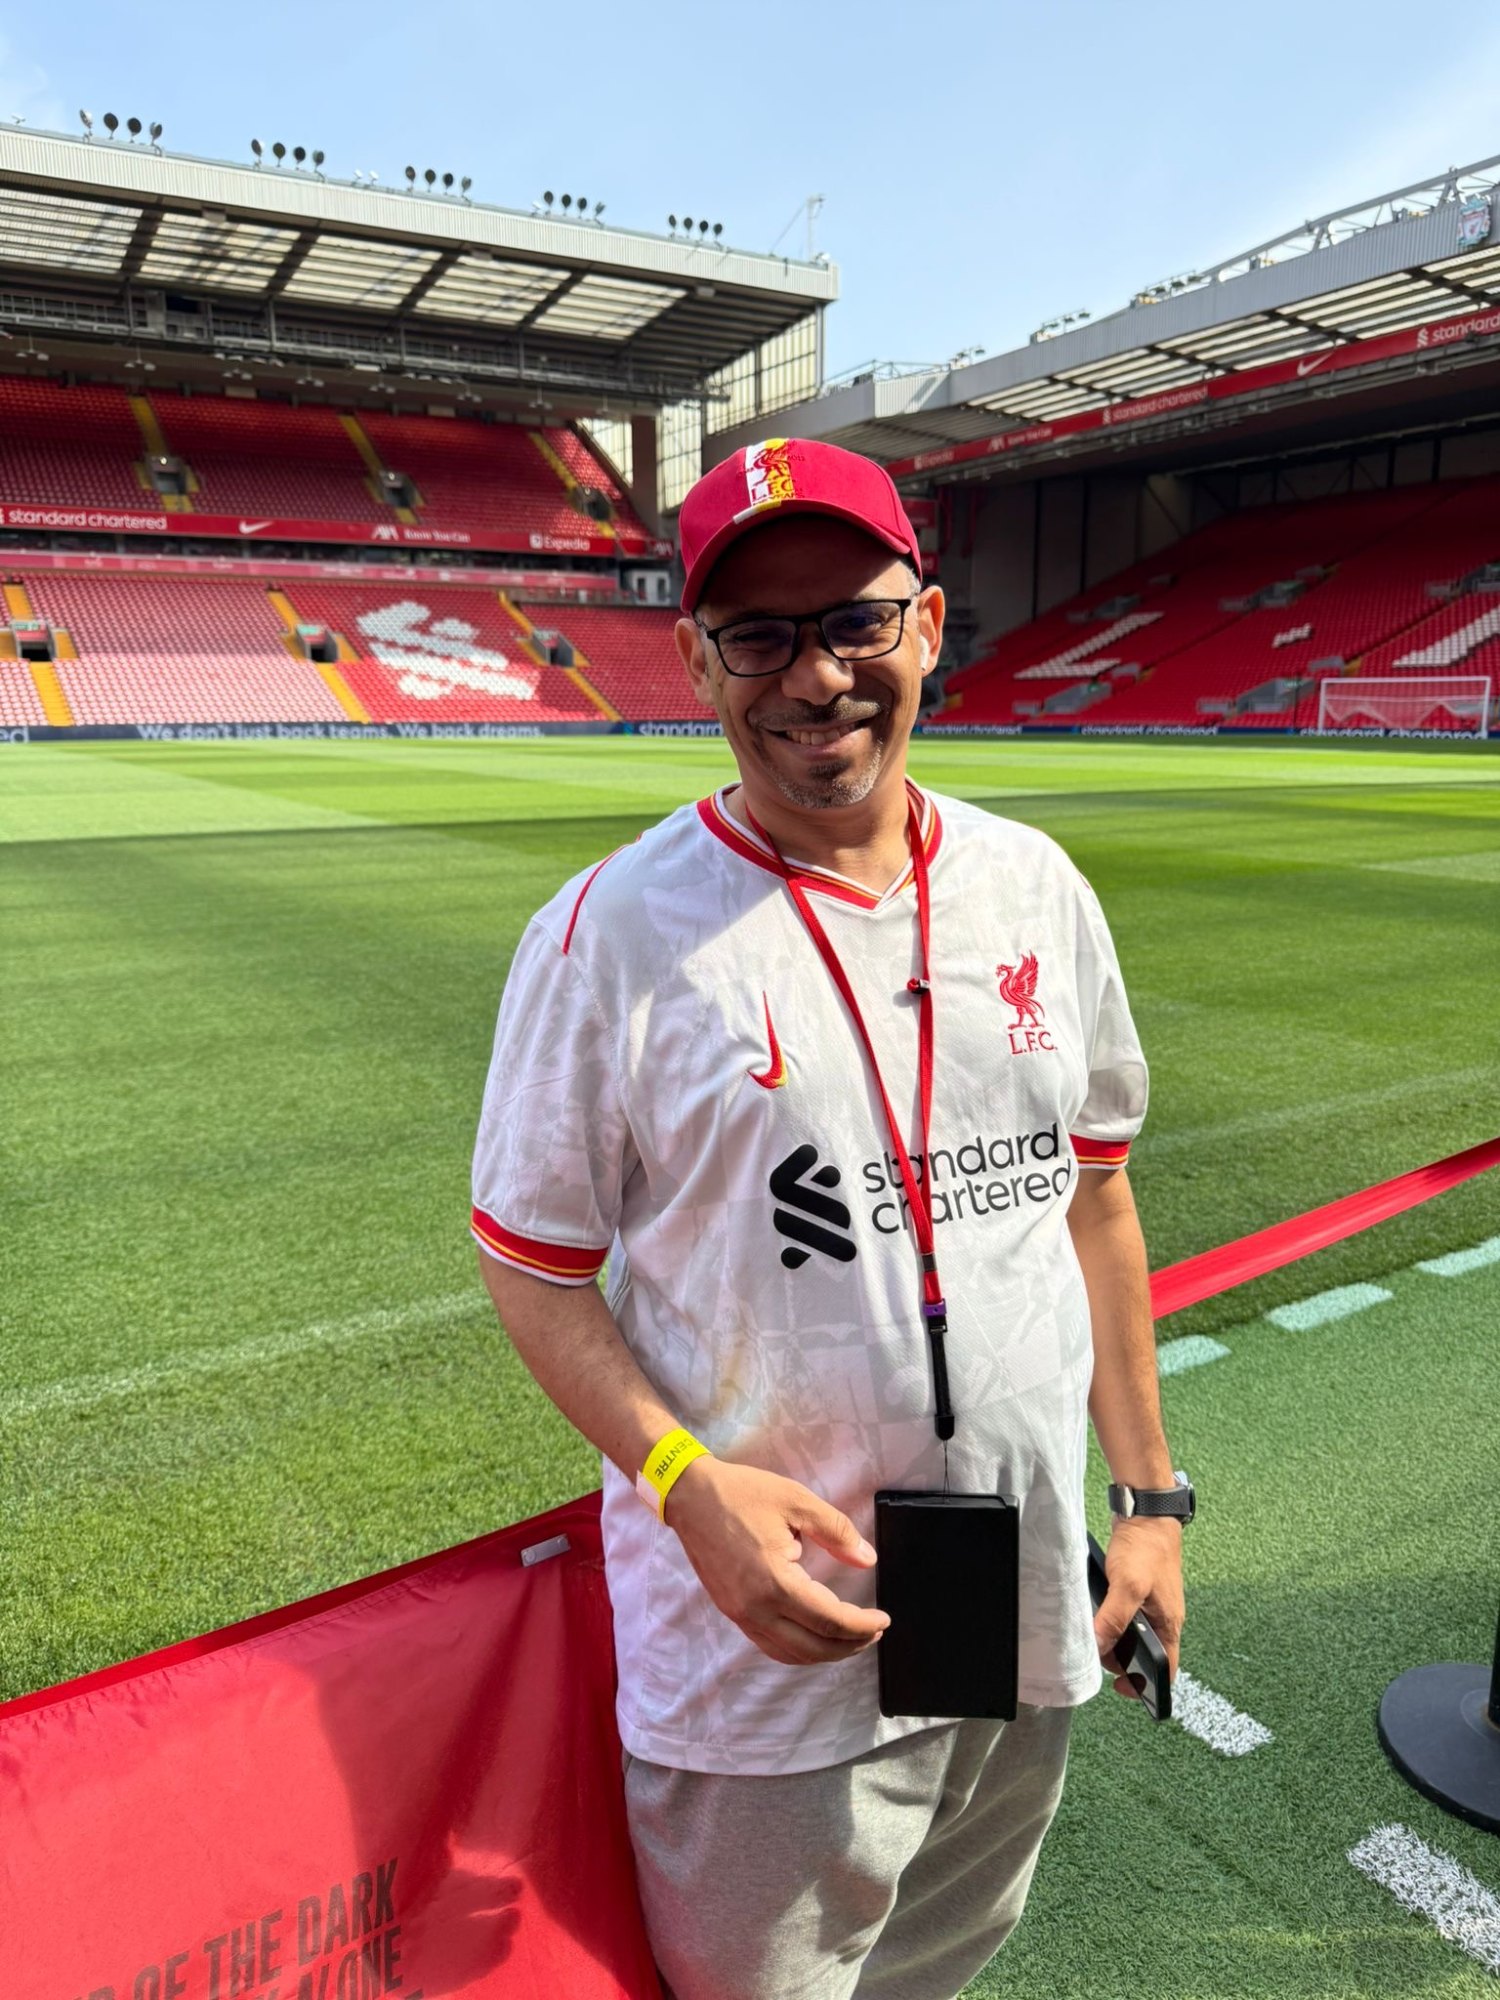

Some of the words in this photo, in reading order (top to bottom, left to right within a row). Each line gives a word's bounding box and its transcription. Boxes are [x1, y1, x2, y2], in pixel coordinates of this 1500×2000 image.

[9, 508, 87, 527] standard
[88, 512, 167, 530] chartered
[136, 725, 174, 740] We
[178, 724, 232, 740] don't
[236, 723, 273, 740] just
[276, 723, 325, 739] back
[396, 723, 427, 738] We
[431, 723, 475, 738] back
[1008, 1030, 1058, 1055] L.F.C.
[862, 1122, 1060, 1194] standard
[871, 1158, 1071, 1234] chartered
[654, 1438, 694, 1480] CENTRE
[133, 1950, 190, 2000] OF
[203, 1908, 284, 2000] THE
[298, 1858, 399, 1968] DARK
